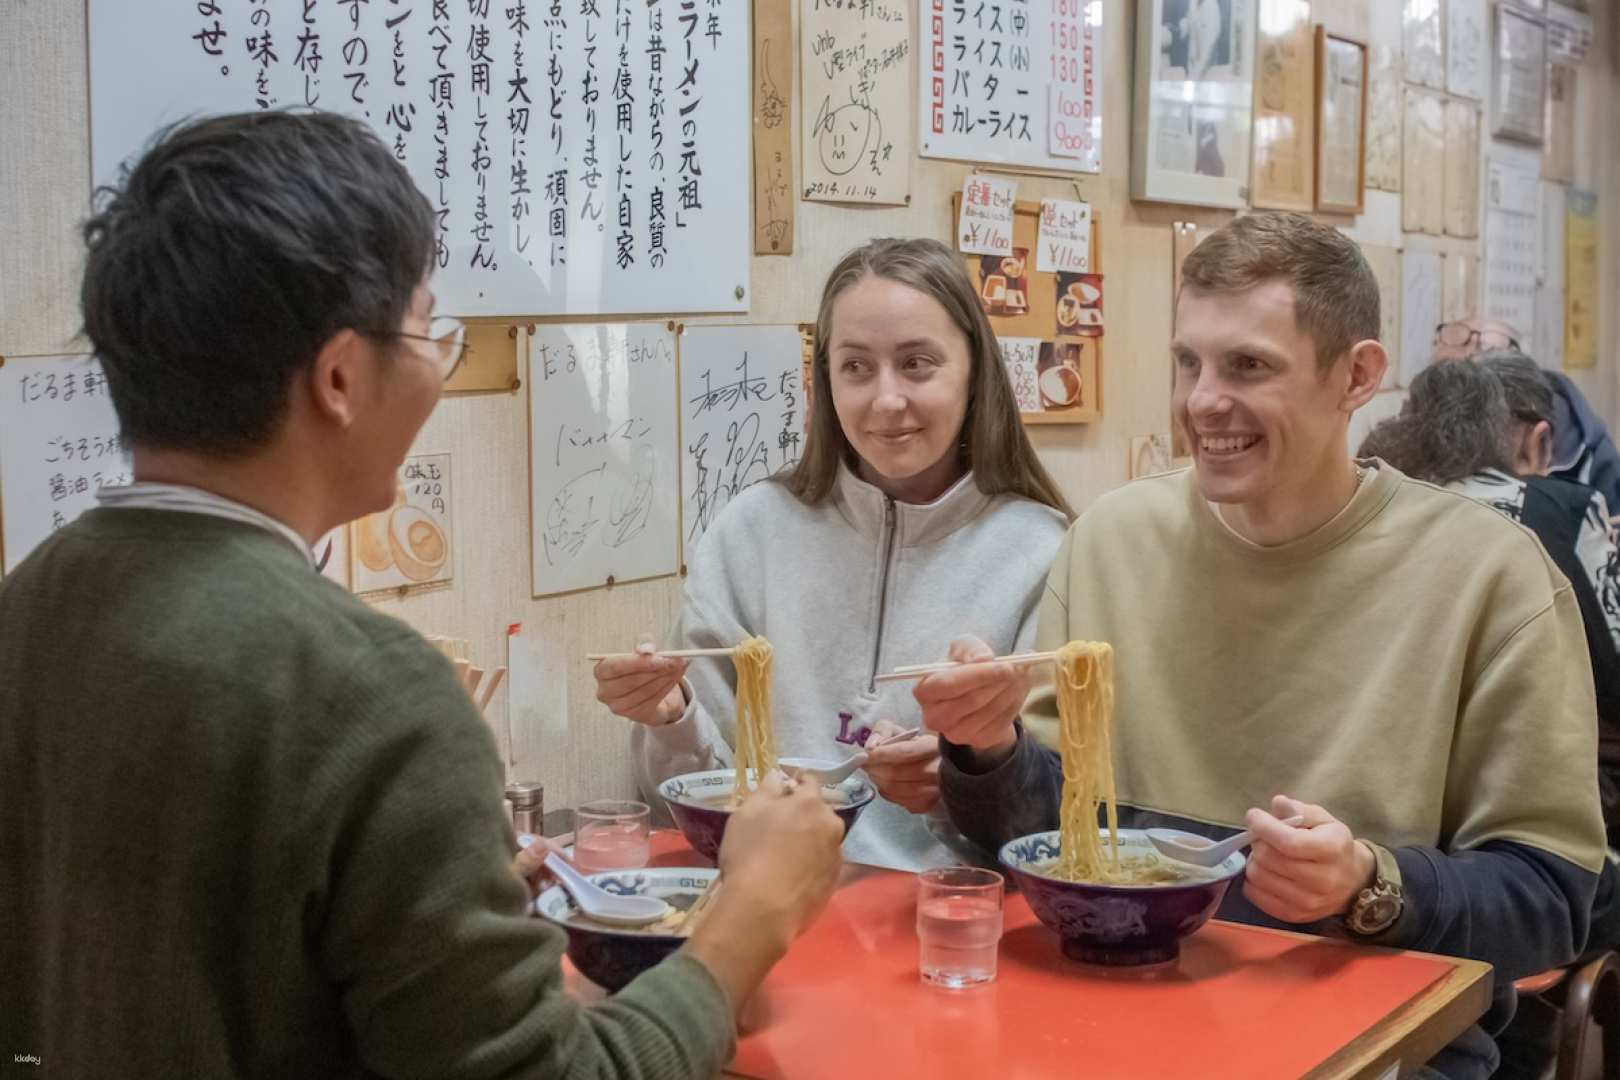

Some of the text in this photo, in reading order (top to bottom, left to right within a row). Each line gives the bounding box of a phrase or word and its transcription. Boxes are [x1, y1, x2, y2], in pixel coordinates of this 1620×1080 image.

[704, 0, 722, 51] 年
[1050, 21, 1078, 51] 150
[1050, 54, 1078, 83] 130
[952, 68, 1029, 102] バター
[676, 2, 702, 228] ラーメンの元祖」
[1058, 91, 1082, 118] 100
[645, 0, 668, 269] は昔ながらの、良質の
[952, 104, 1032, 142] カレーライス
[1055, 121, 1082, 149] 900
[970, 222, 1010, 249] ¥1100
[1049, 243, 1087, 268] ¥1100
[405, 463, 441, 480] 味玉
[415, 483, 442, 496] 120
[432, 497, 445, 514] 円
